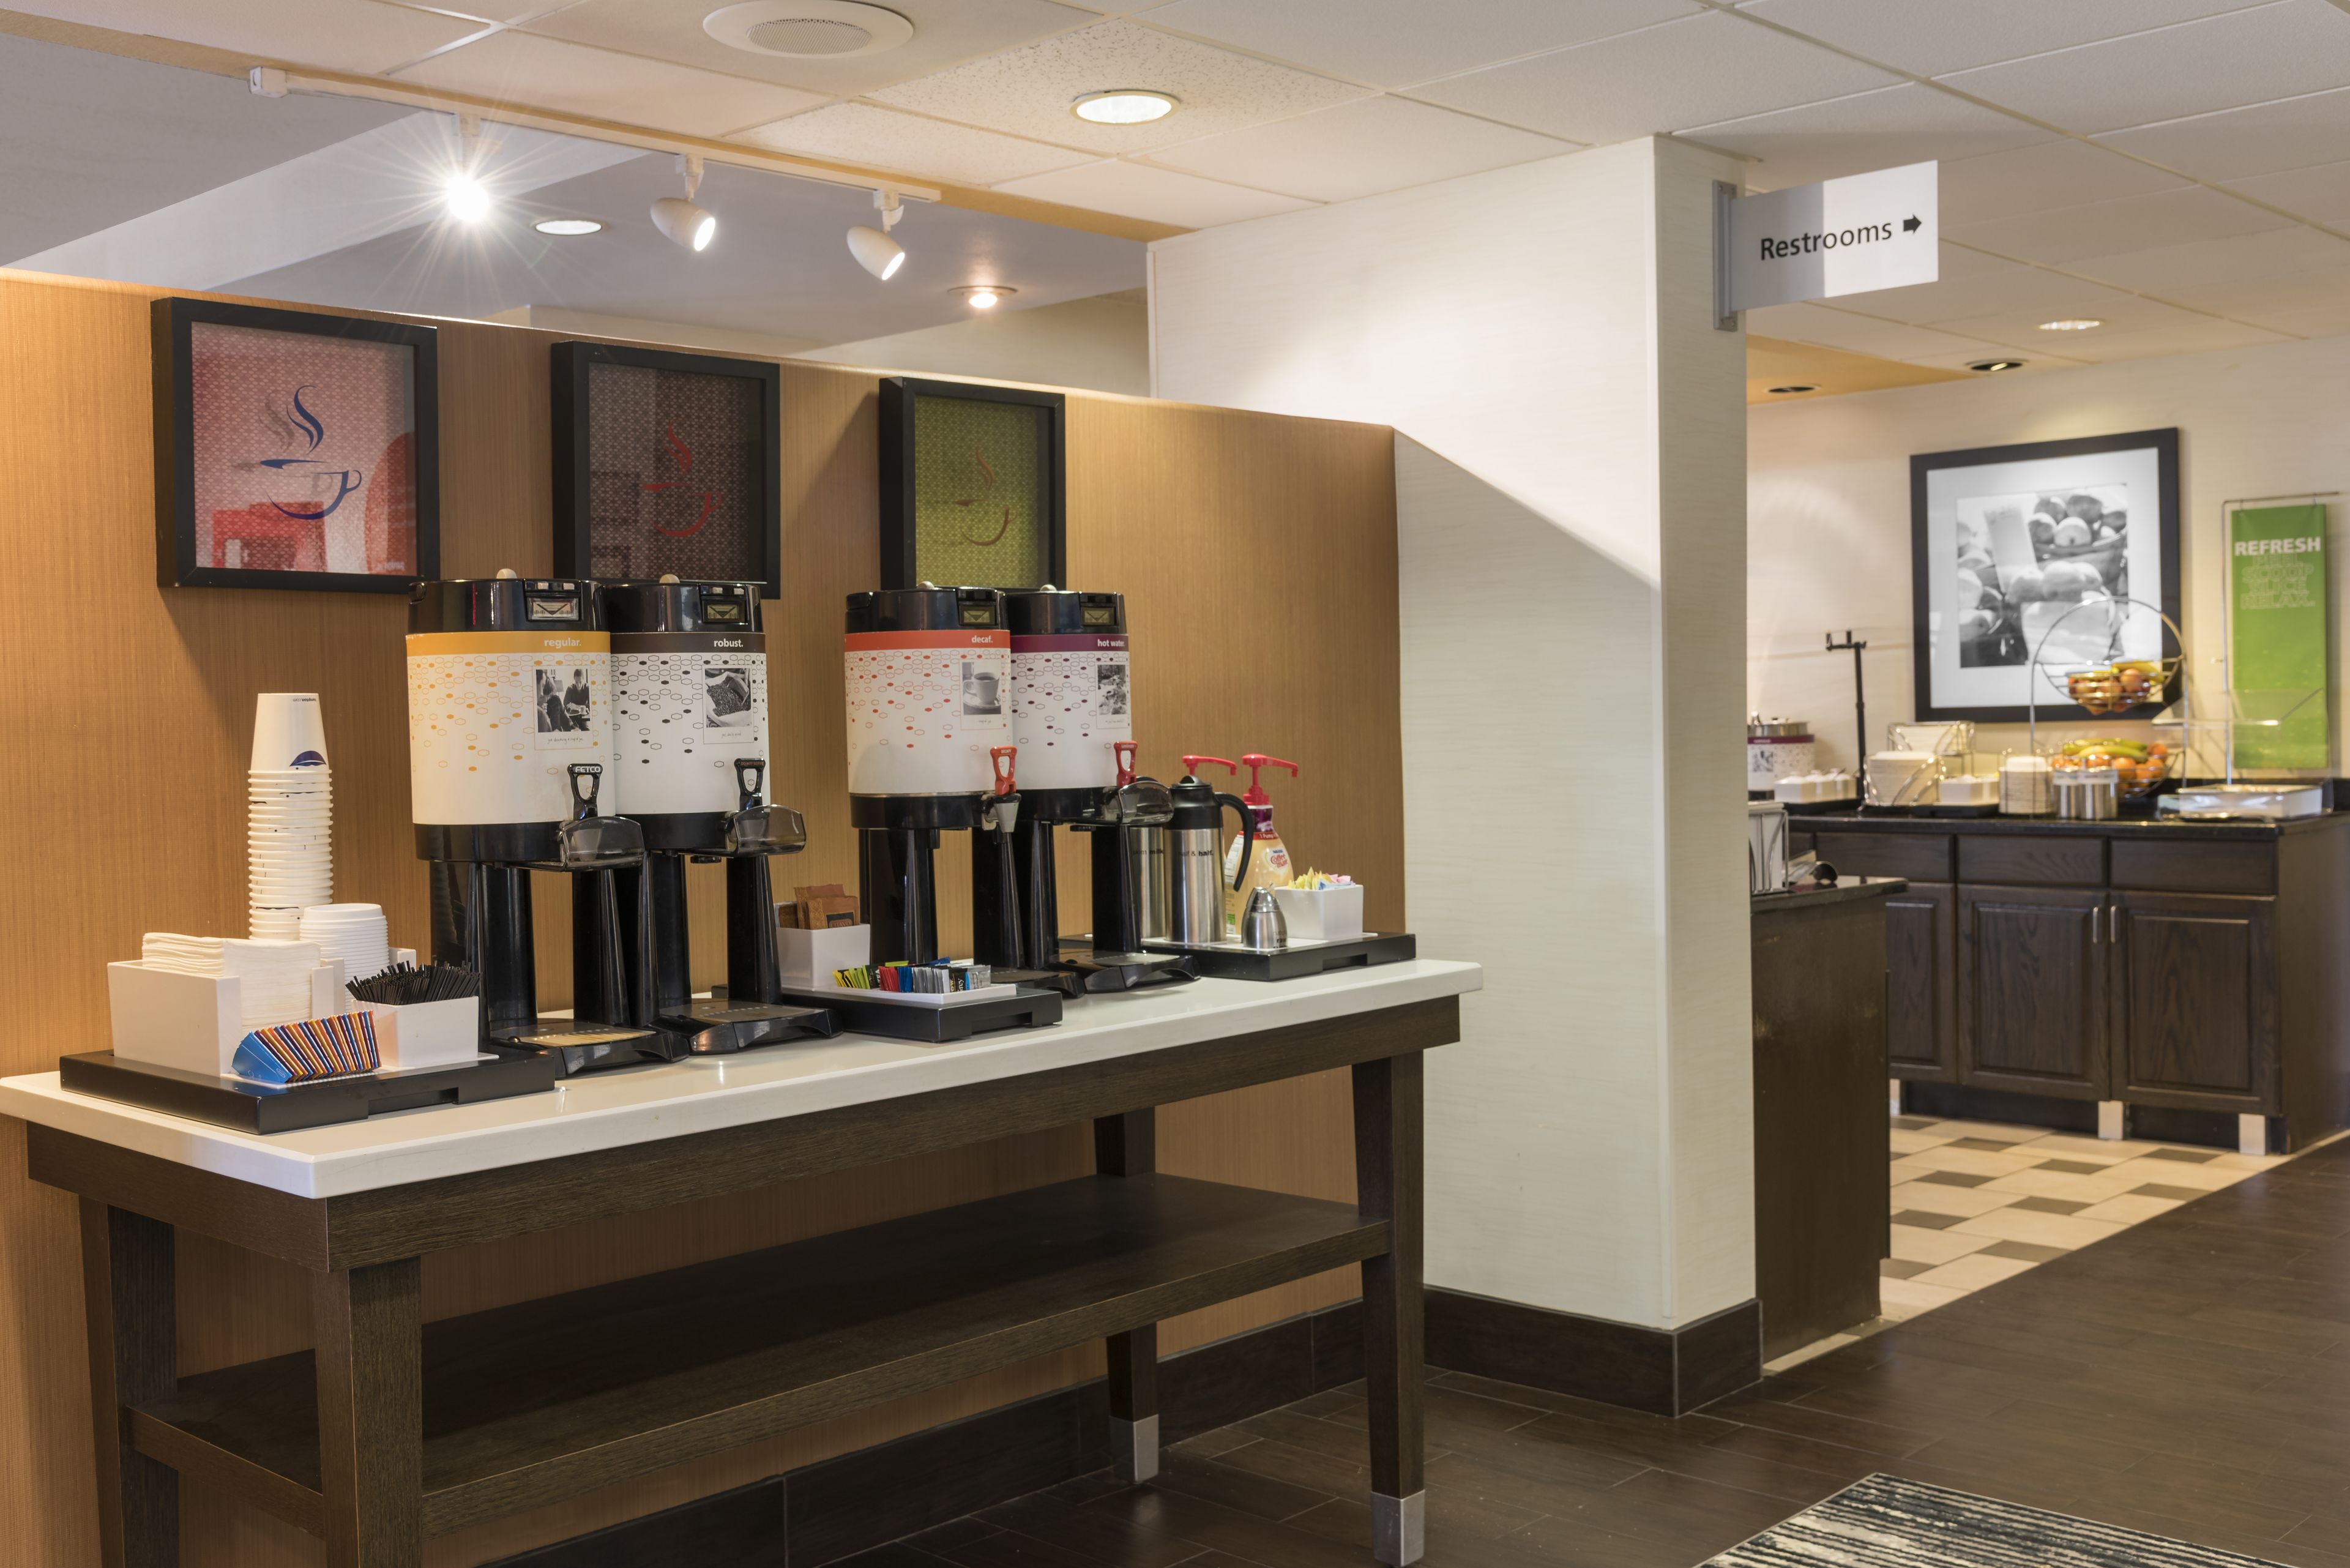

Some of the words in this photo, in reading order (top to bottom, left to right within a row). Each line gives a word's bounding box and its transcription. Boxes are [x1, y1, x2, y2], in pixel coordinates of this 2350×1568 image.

[1761, 222, 1892, 261] Restrooms
[2234, 536, 2321, 556] REFRESH
[2242, 563, 2315, 582] SCOOP
[544, 638, 581, 649] regular.
[714, 638, 744, 647] robust.
[971, 635, 993, 643] decaf.
